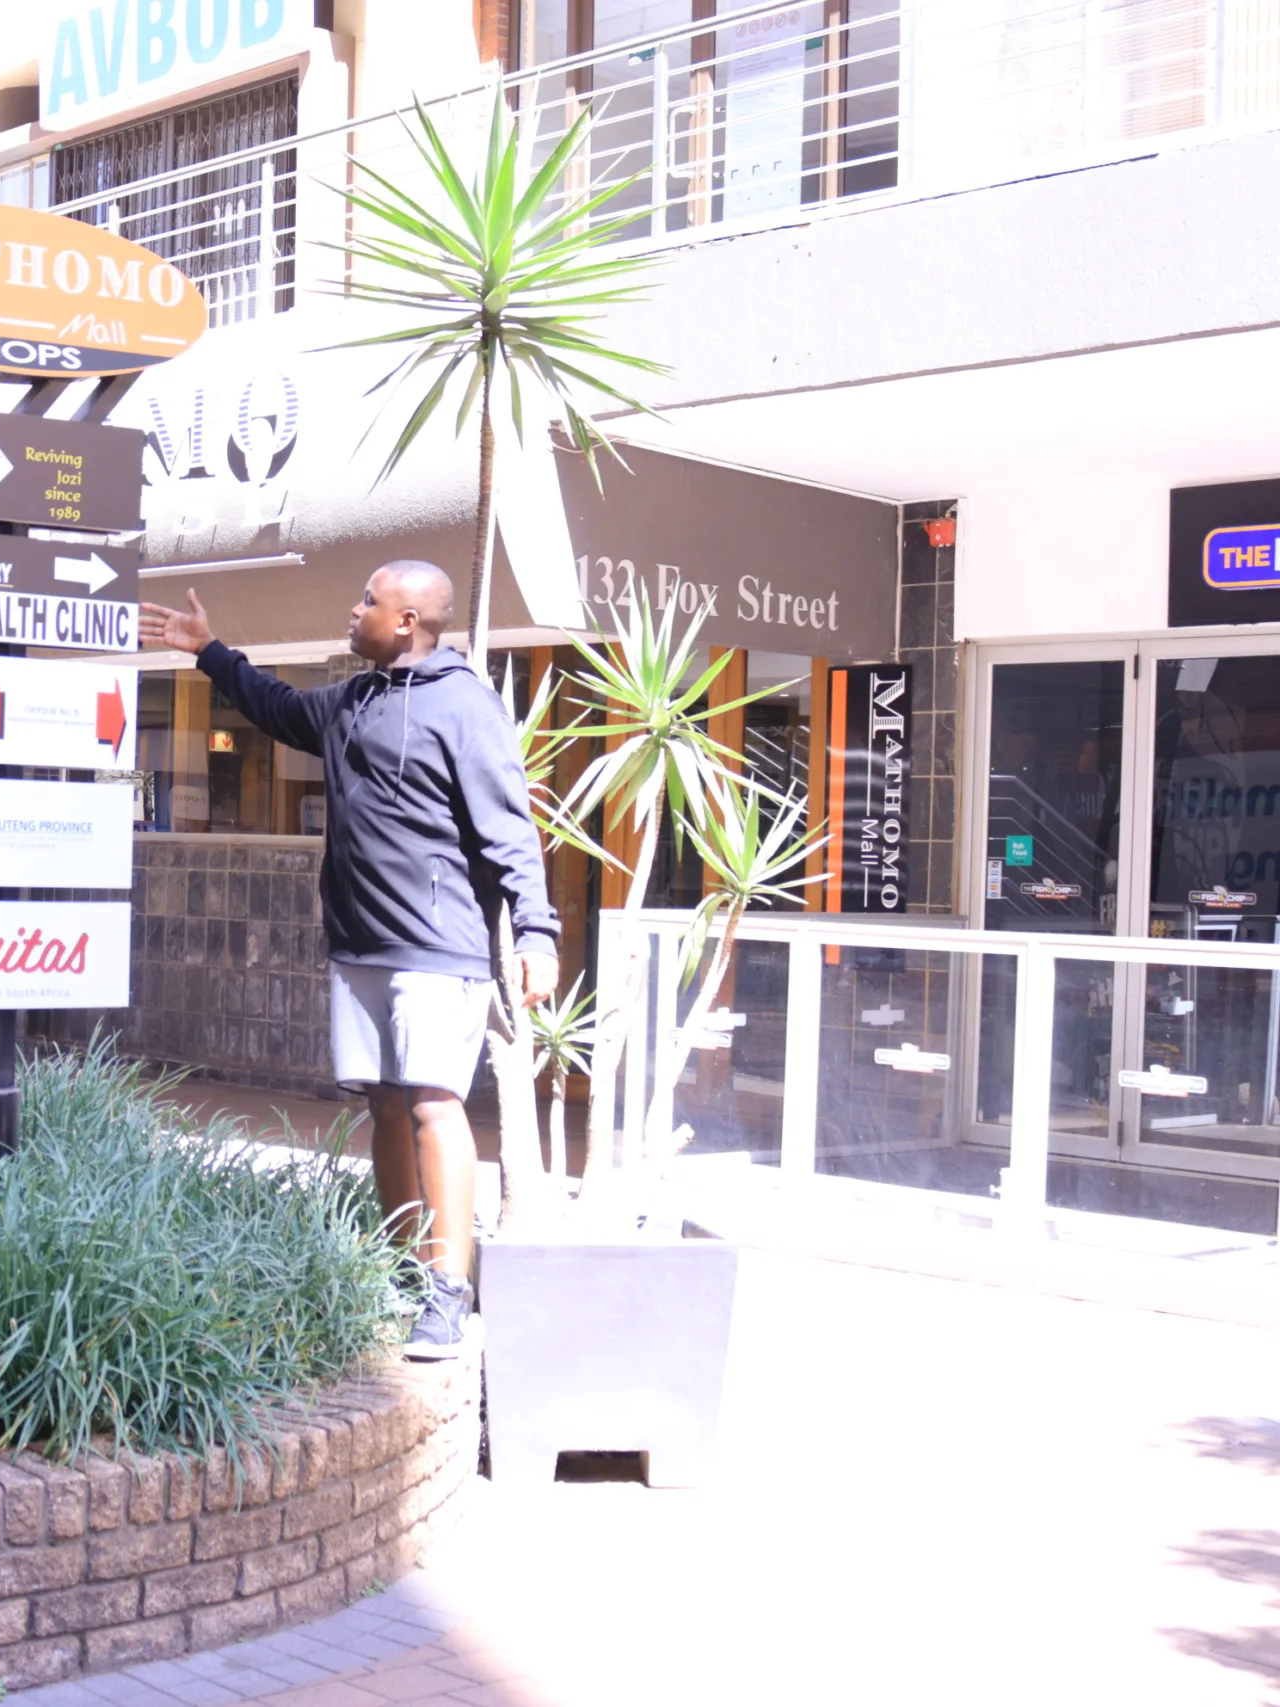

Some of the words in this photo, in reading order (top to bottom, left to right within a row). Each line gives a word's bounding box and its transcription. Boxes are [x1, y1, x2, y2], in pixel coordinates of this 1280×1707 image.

[58, 313, 127, 345] Mall
[25, 446, 82, 469] Reviving
[57, 469, 82, 485] Jozi
[44, 485, 81, 502] since
[49, 506, 81, 522] 1989
[1218, 545, 1271, 569] THE
[576, 555, 636, 606] 132
[655, 563, 719, 617] Fox
[737, 574, 839, 631] Street
[56, 600, 130, 647] CLINIC
[871, 671, 906, 909] MATHOMO
[39, 820, 94, 834] PROVINCE
[861, 819, 879, 866] Mall
[6, 988, 36, 999] South
[40, 987, 71, 998] Africa
